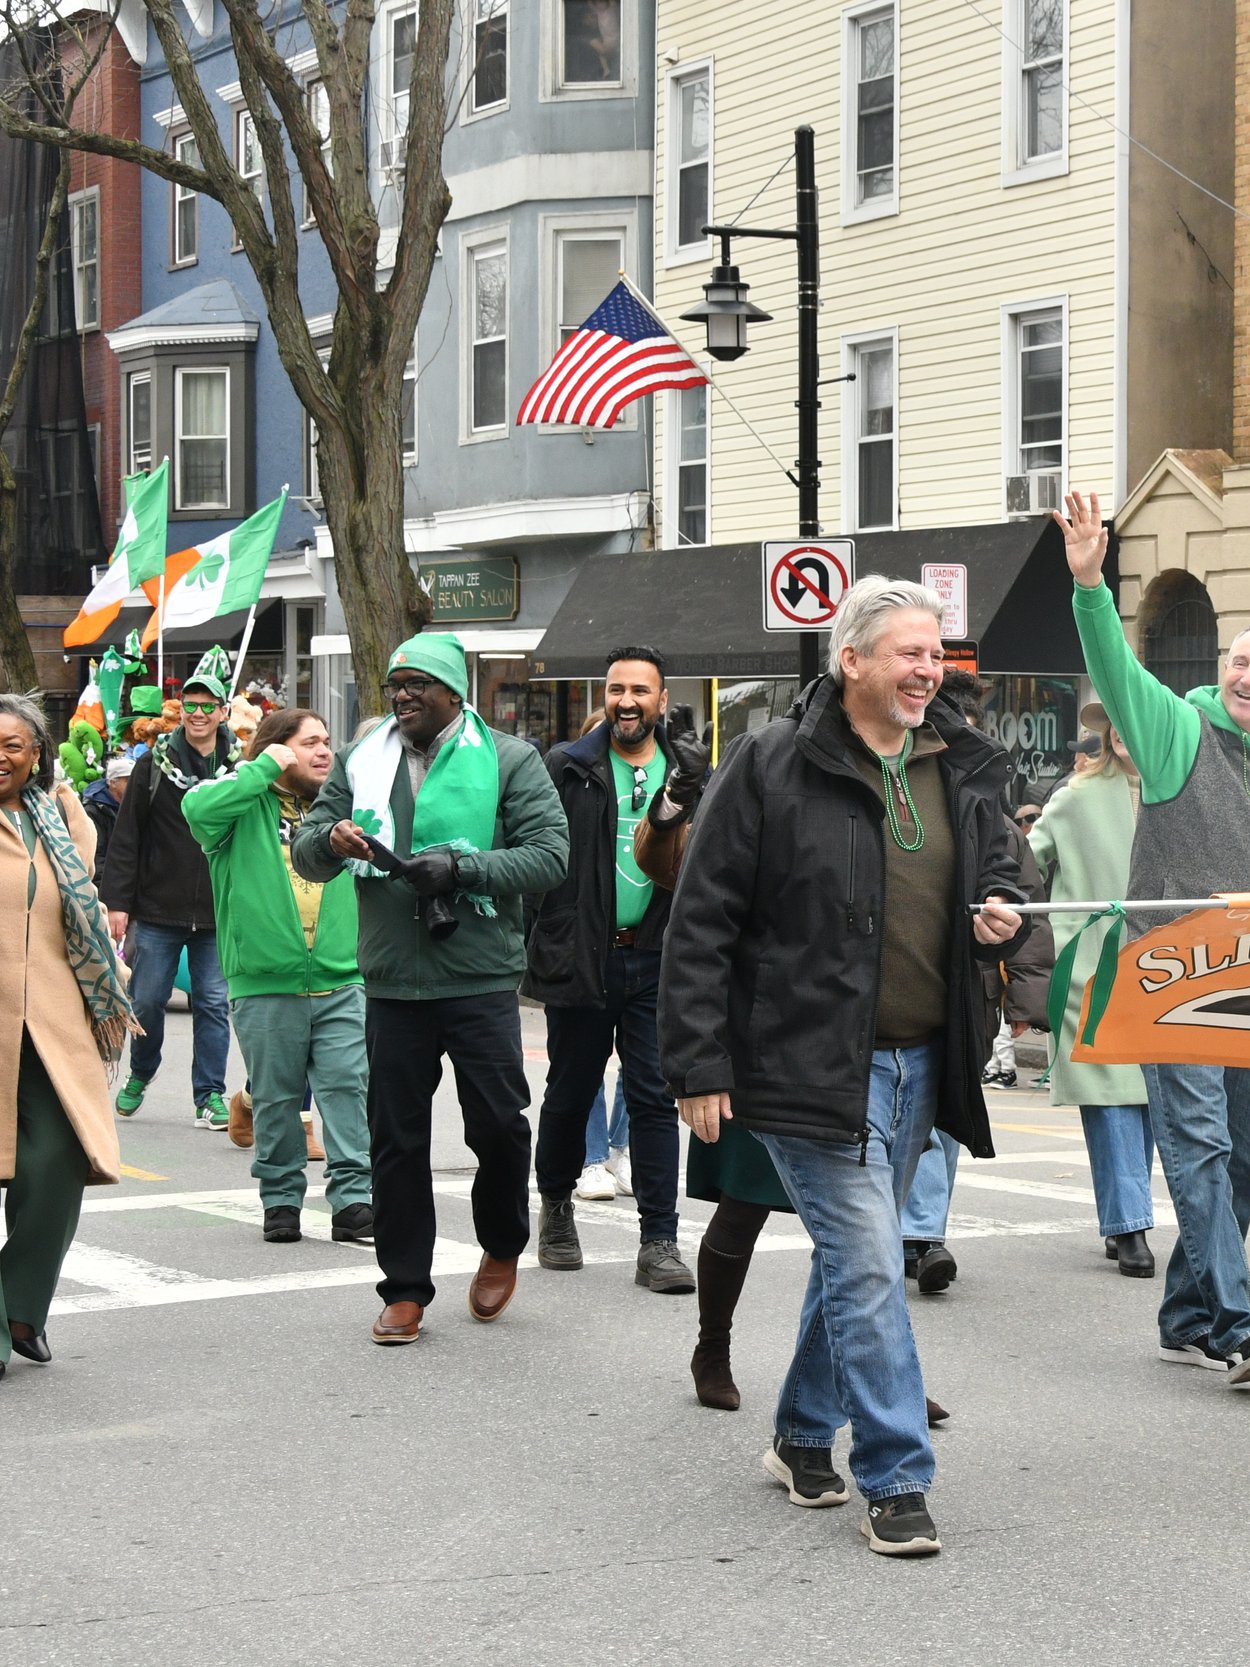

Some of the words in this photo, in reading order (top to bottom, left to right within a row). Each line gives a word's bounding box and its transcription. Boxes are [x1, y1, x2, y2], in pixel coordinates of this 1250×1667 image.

[438, 574, 464, 588] TAPPAN
[466, 572, 481, 586] ZEE
[929, 569, 959, 578] LOADING
[934, 580, 953, 589] ZONE
[438, 590, 476, 609] BEAUTY
[480, 589, 513, 607] SALON
[717, 656, 760, 673] BARBER
[764, 655, 798, 671] SHOP
